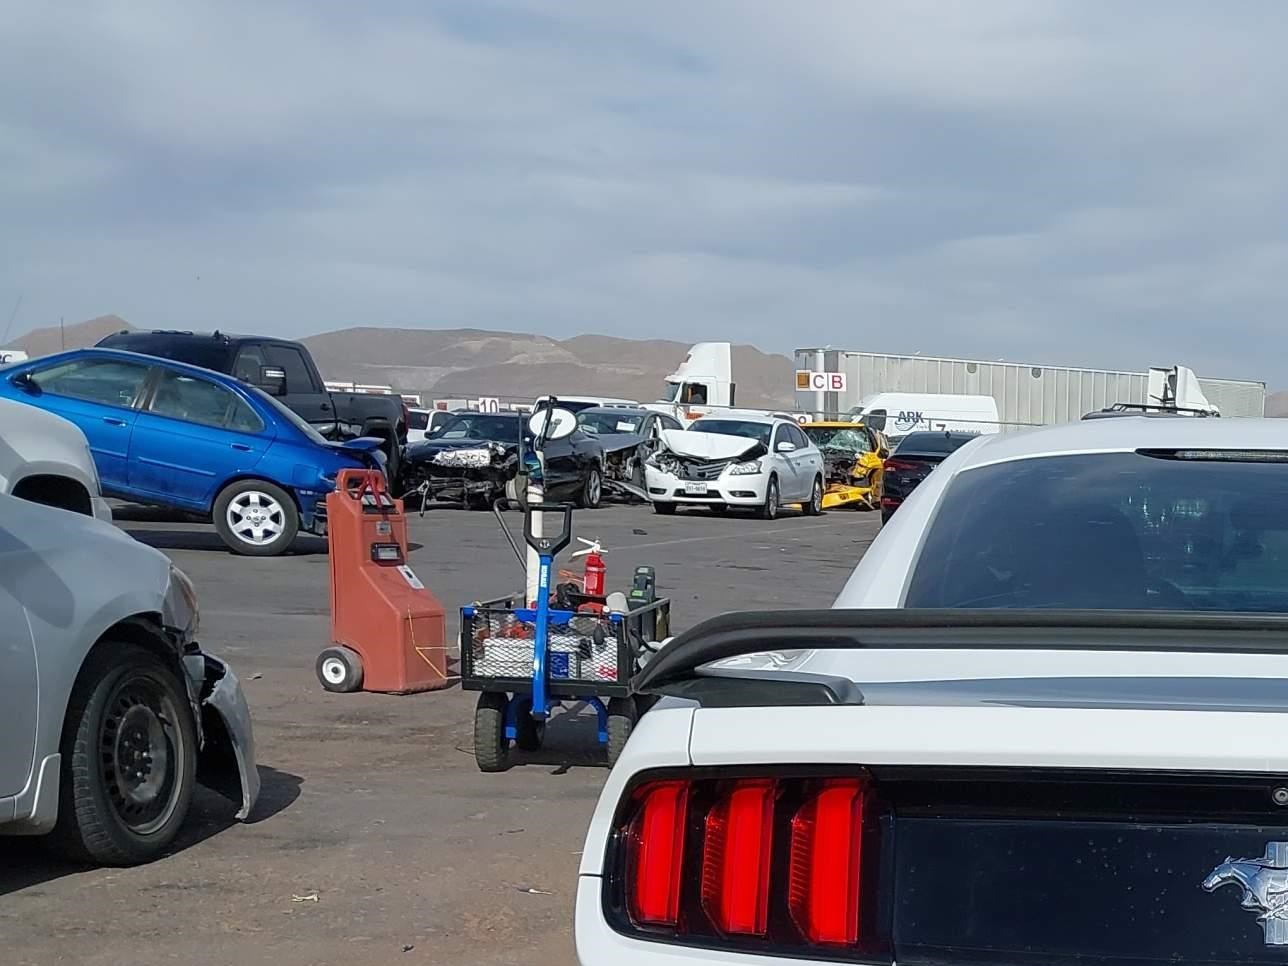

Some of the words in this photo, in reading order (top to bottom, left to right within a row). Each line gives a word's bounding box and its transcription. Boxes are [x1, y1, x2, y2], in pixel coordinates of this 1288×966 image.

[813, 374, 825, 389] C
[832, 374, 843, 389] B
[897, 411, 924, 423] ARK
